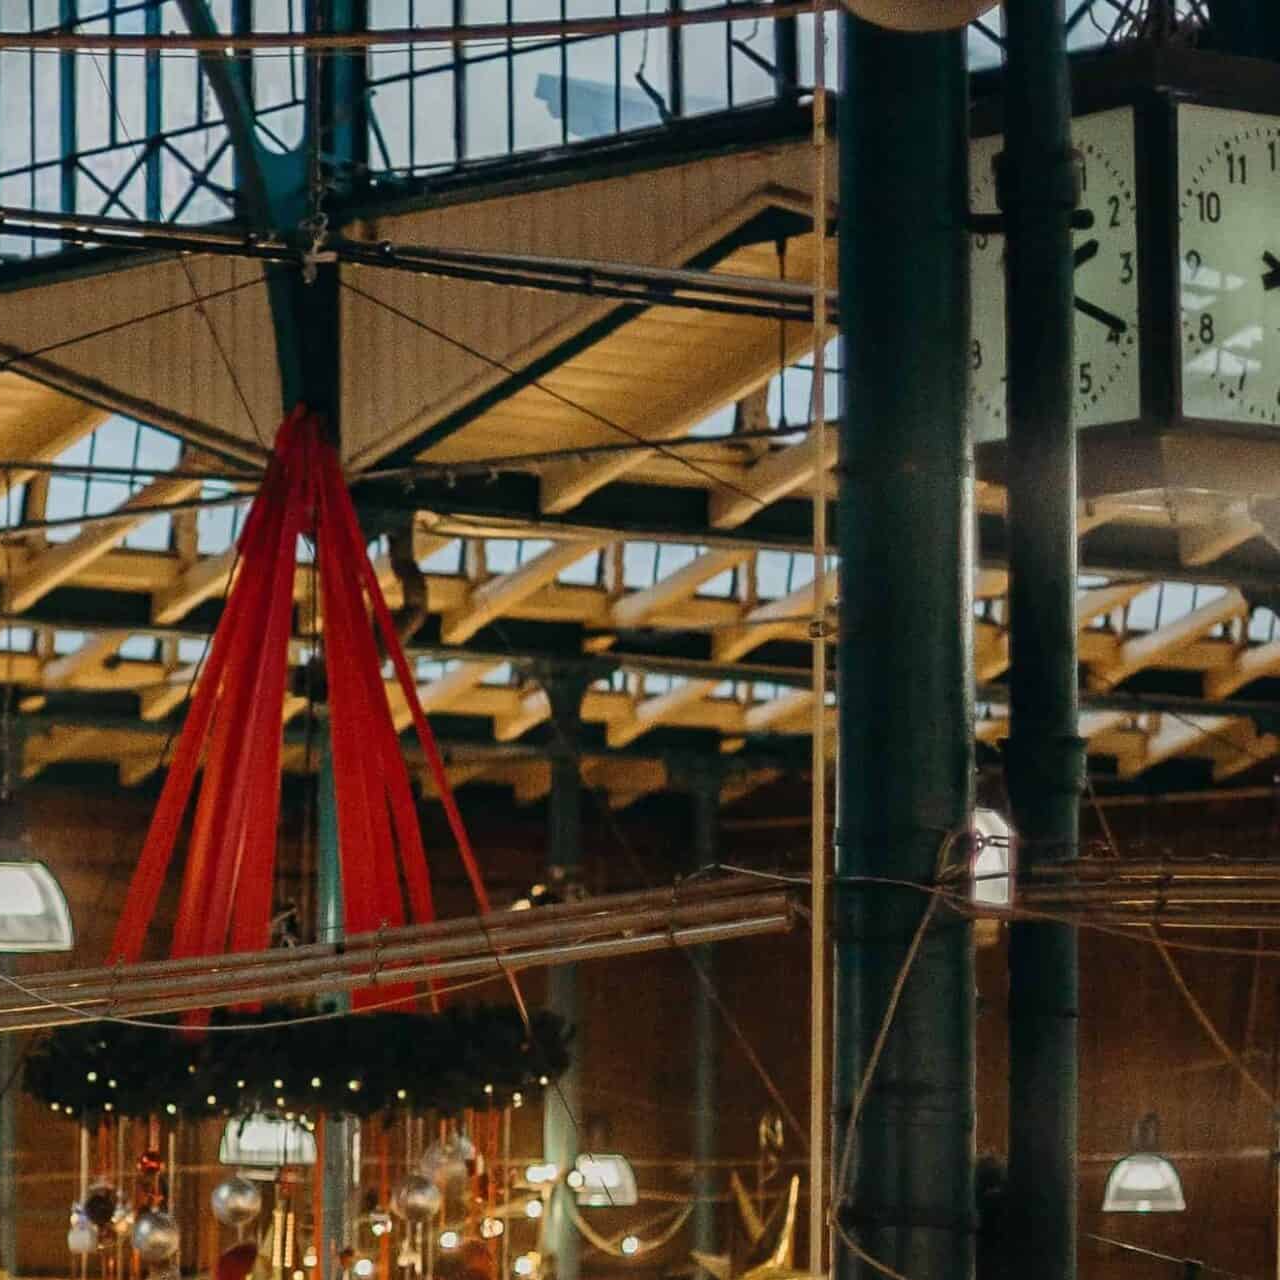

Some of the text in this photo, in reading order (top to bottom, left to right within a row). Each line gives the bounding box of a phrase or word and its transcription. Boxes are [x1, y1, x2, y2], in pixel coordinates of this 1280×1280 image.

[1226, 153, 1247, 185] 11
[1107, 195, 1122, 229] 2
[1197, 191, 1222, 224] 10
[1120, 251, 1133, 285] 3
[1199, 313, 1215, 345] 8
[1079, 362, 1092, 395] 5
